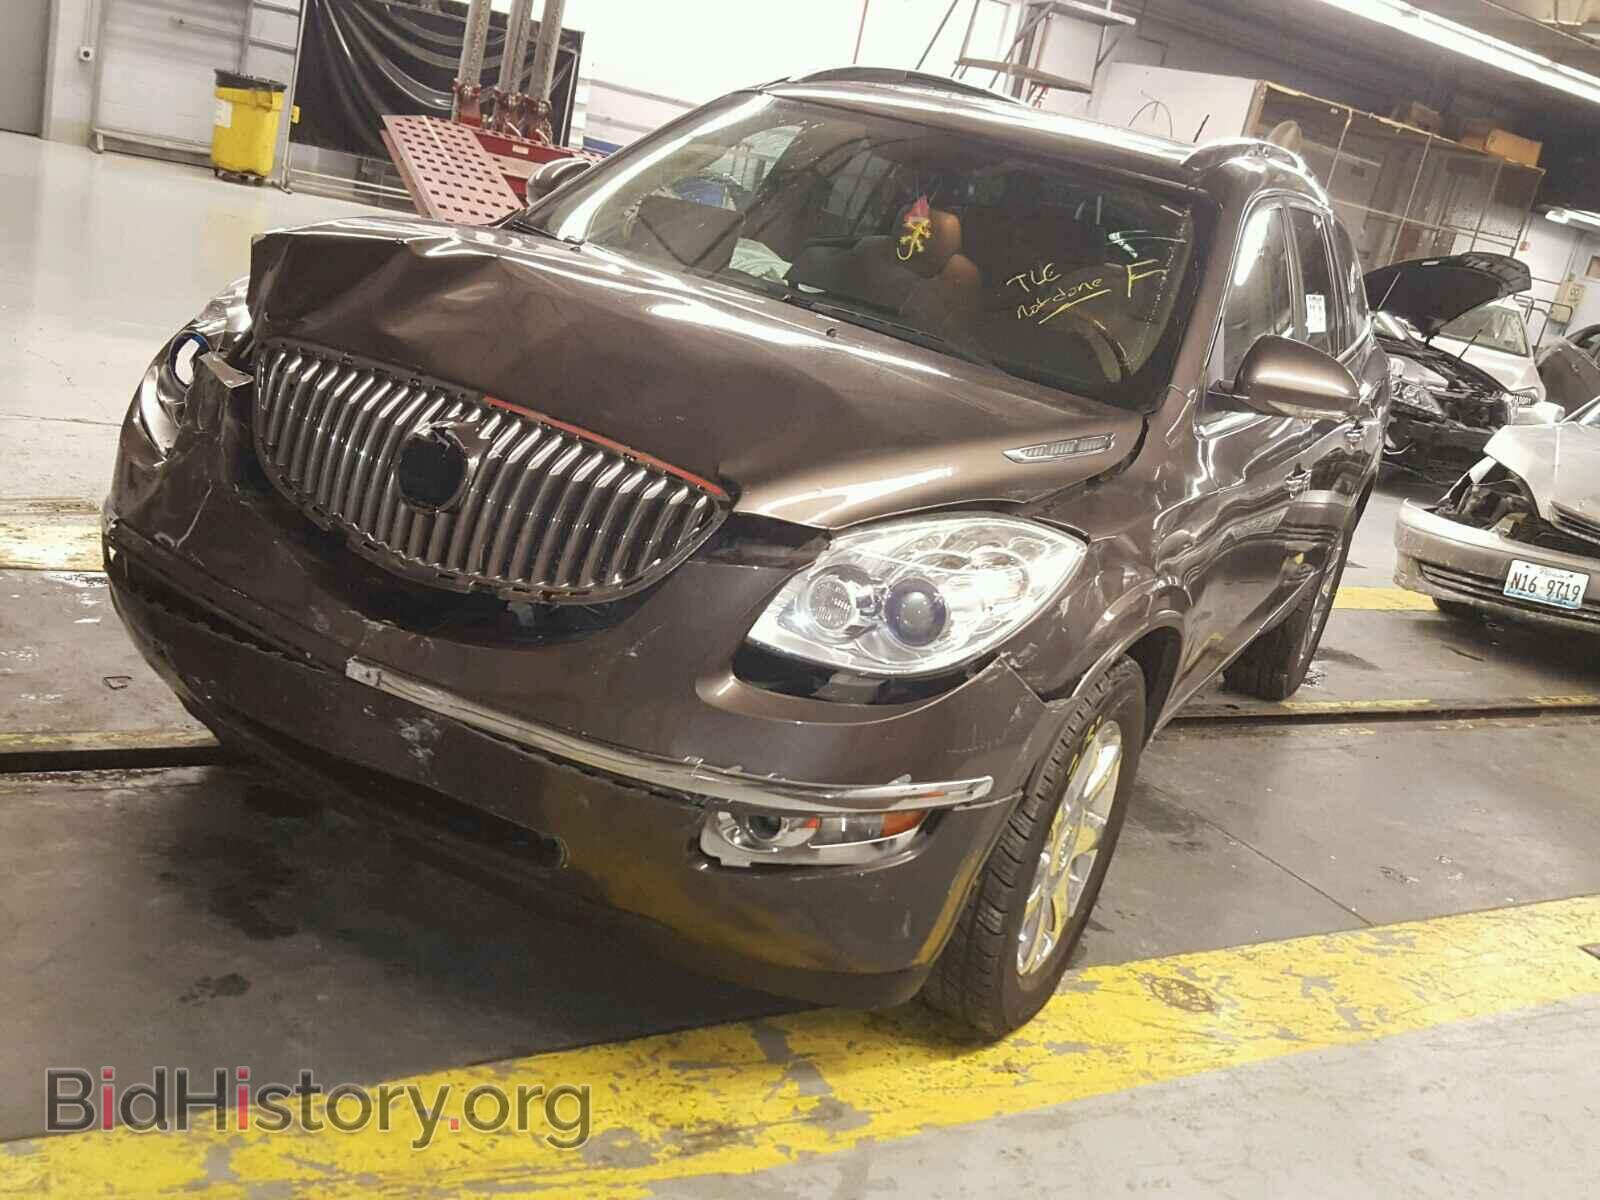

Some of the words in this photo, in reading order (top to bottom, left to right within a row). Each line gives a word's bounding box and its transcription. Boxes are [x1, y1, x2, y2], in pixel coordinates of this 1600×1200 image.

[1126, 259, 1169, 298] F
[1510, 571, 1538, 594] N16
[1546, 579, 1581, 602] 9719
